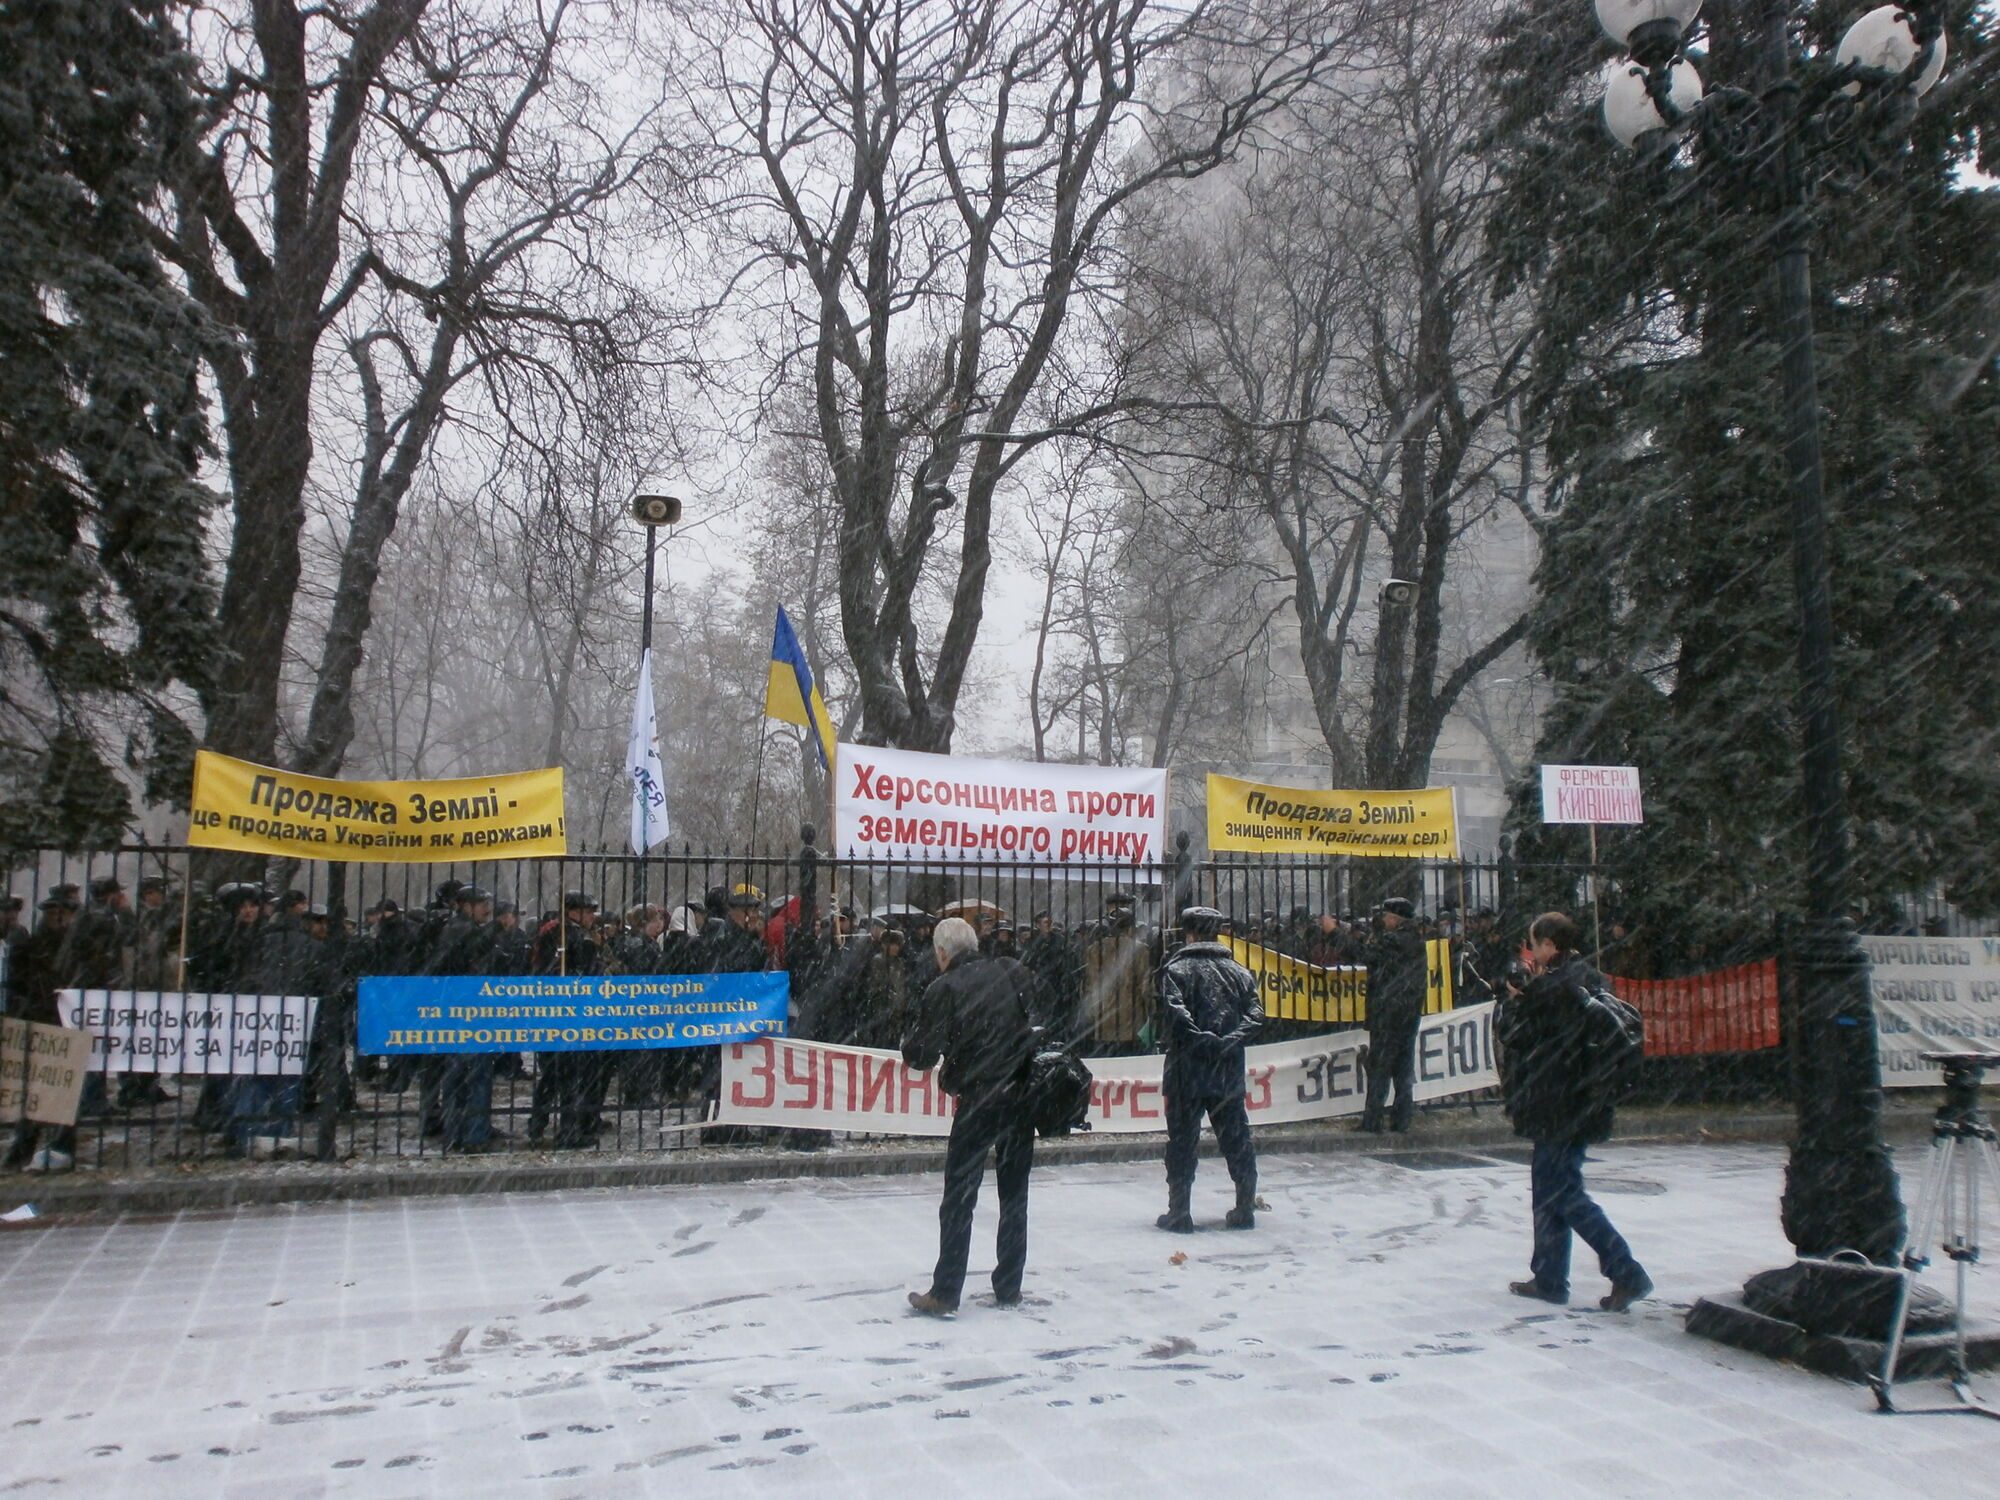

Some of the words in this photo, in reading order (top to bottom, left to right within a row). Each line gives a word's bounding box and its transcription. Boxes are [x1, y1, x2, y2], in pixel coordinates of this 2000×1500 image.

[1560, 769, 1630, 787] ФЕРМЕРИ
[250, 774, 397, 825] Продажа
[409, 788, 499, 824] Землі
[852, 763, 1057, 815] Херсонщина
[1067, 790, 1155, 823] проти
[1247, 791, 1352, 824] Продажа
[1359, 800, 1415, 824] Землі
[193, 809, 221, 829] це
[228, 814, 327, 842] продажа
[334, 825, 422, 848] України
[430, 832, 454, 847] як
[461, 823, 552, 848] держави
[857, 815, 1050, 852] земельного
[1059, 829, 1149, 865] ринку
[1225, 822, 1302, 842] знищення
[1307, 825, 1407, 846] Українських
[1413, 832, 1439, 845] сел
[479, 980, 591, 999] Асоціація
[598, 978, 704, 999] фермерів
[71, 1007, 222, 1029] СЕЛЯНСЬКИЙ
[417, 1006, 441, 1018] та
[449, 1004, 577, 1022] приватних
[583, 998, 758, 1017] землевласників
[386, 1022, 675, 1047] ДНІПРОПЕТРОВСЬКОЇ
[682, 1019, 785, 1038] ОБЛАСТІ
[194, 1038, 222, 1057] ЗА
